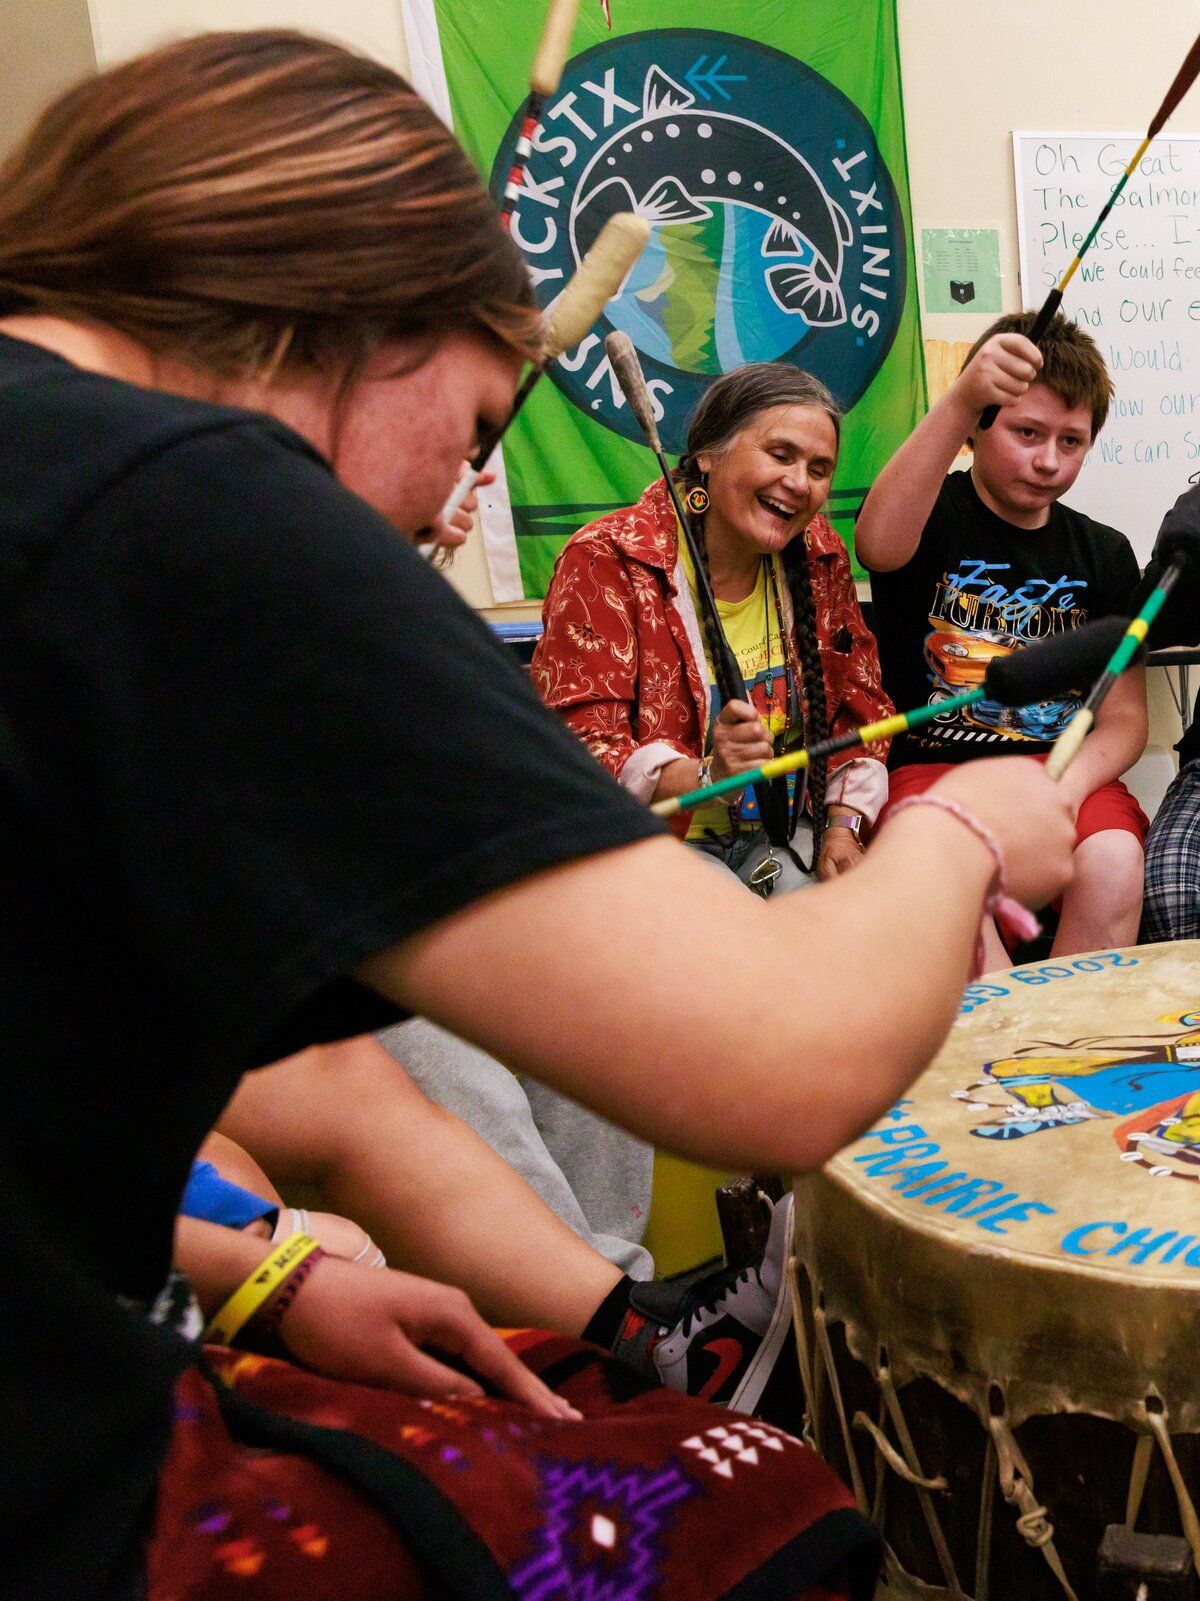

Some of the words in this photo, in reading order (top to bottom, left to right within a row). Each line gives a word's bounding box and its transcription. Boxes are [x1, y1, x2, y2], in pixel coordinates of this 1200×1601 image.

[1035, 144, 1081, 176] Oh
[1097, 143, 1183, 177] Geat
[853, 1123, 1058, 1235] PRAIRIE
